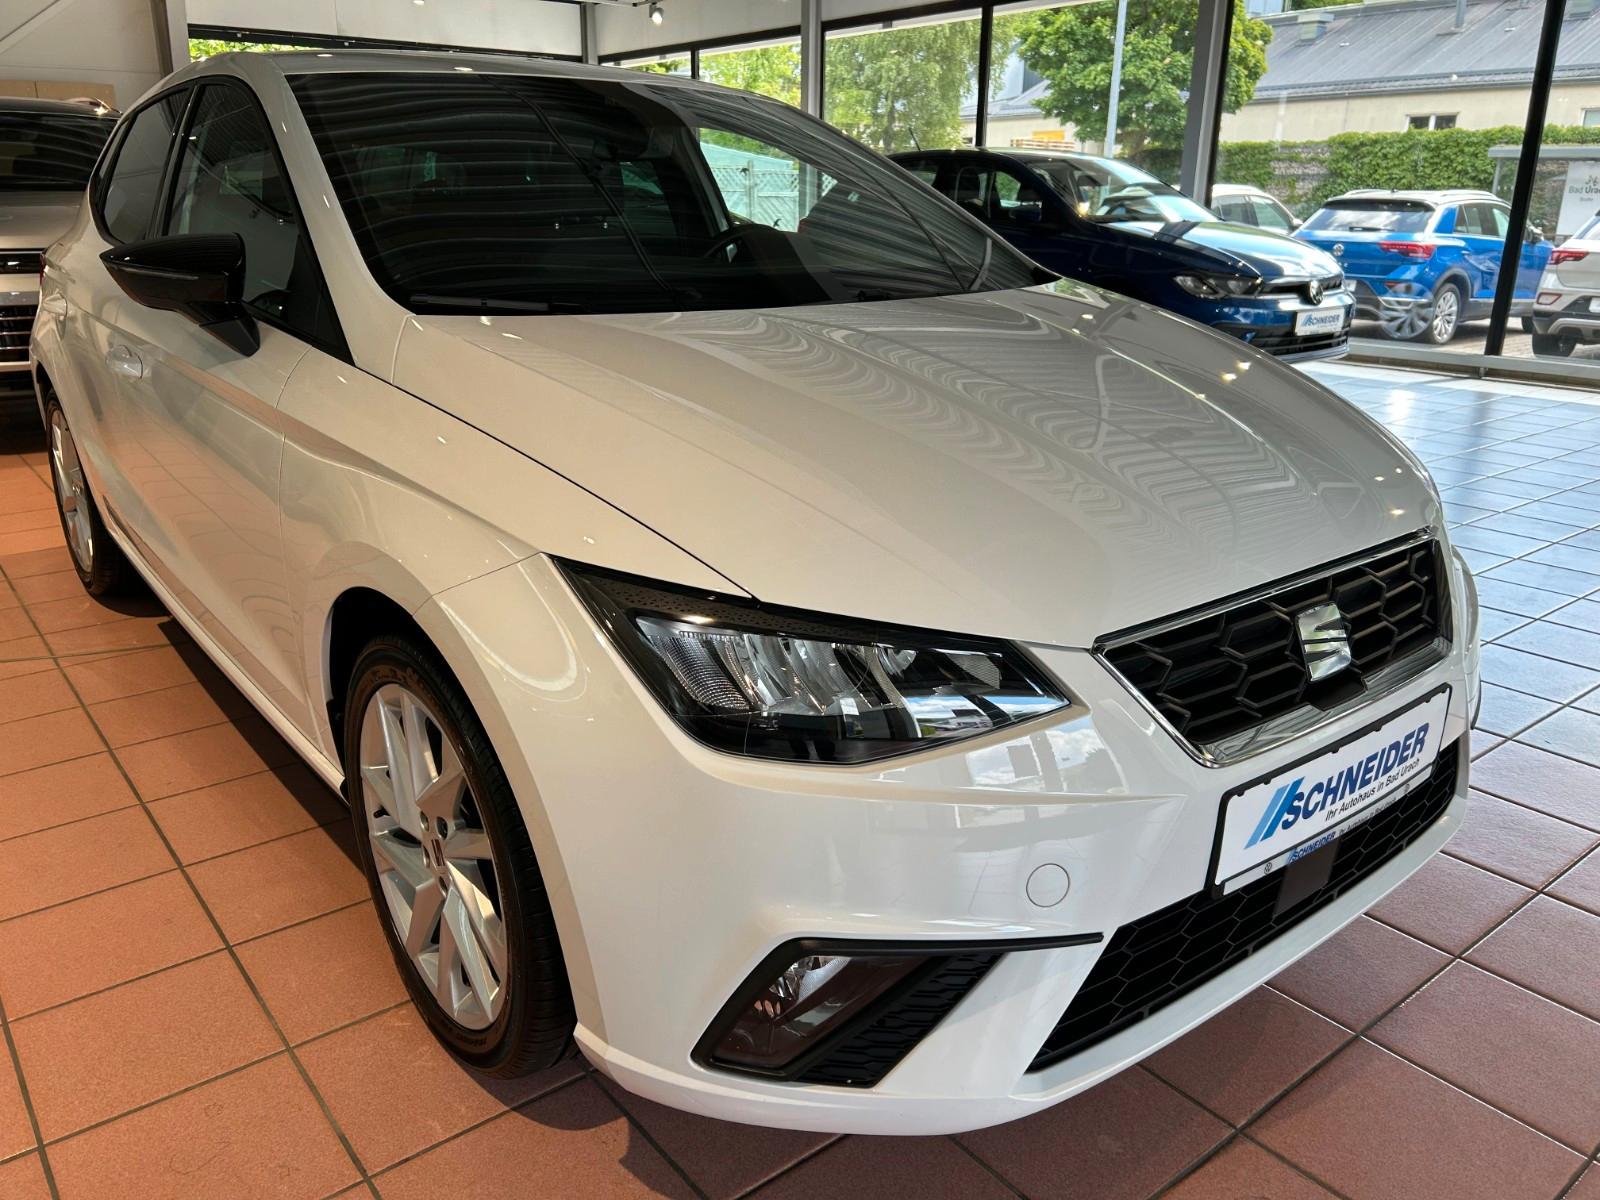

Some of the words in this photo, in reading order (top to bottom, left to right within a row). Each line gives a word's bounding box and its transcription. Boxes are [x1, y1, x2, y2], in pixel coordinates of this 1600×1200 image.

[1281, 722, 1430, 831] SCHNEIDER
[1325, 807, 1338, 822] Ihr
[1339, 785, 1376, 815] Autohaus
[1377, 781, 1385, 793] in
[1385, 771, 1400, 787] Bad
[1400, 758, 1420, 777] Urach
[1292, 831, 1336, 860] SCHNEIDER
